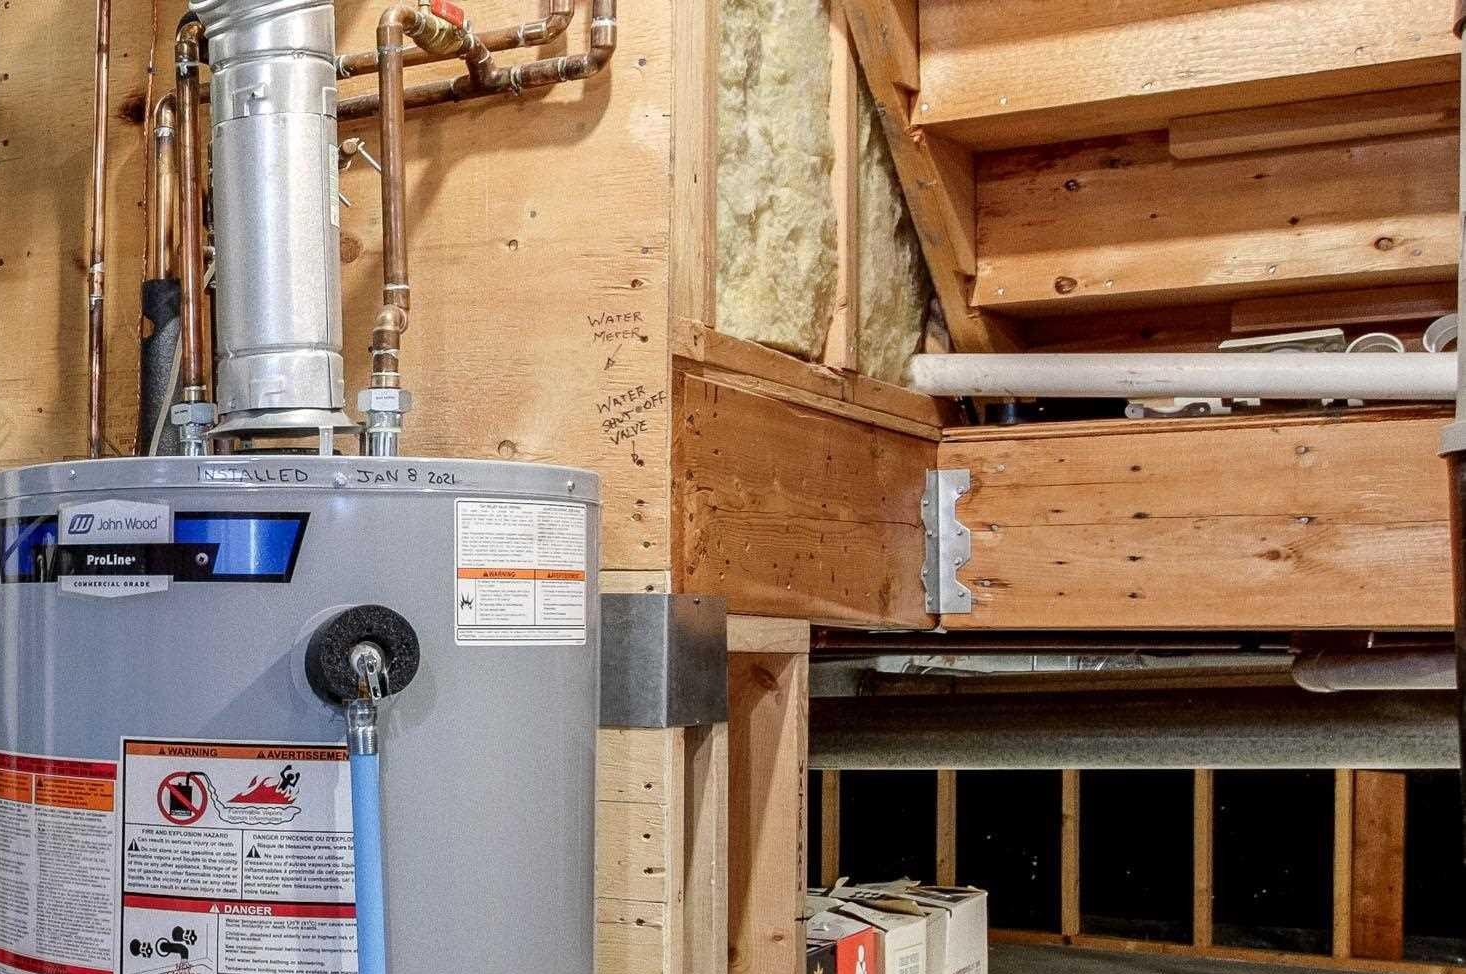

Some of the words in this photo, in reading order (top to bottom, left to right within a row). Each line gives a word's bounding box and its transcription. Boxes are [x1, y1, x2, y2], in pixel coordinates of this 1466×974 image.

[587, 311, 644, 327] WATER
[597, 385, 646, 414] WATER
[602, 410, 634, 433] SHUT
[643, 390, 666, 410] OFF
[609, 420, 648, 446] VALVE
[198, 465, 309, 483] INSTALLED
[357, 469, 398, 483] JAN
[408, 468, 417, 482] 8
[97, 518, 123, 530] John
[125, 518, 157, 530] Wood
[86, 554, 132, 566] ProLine
[168, 747, 218, 758] WARNING
[268, 751, 349, 761] AVERTISSEMEN
[224, 905, 272, 916] DANGER
